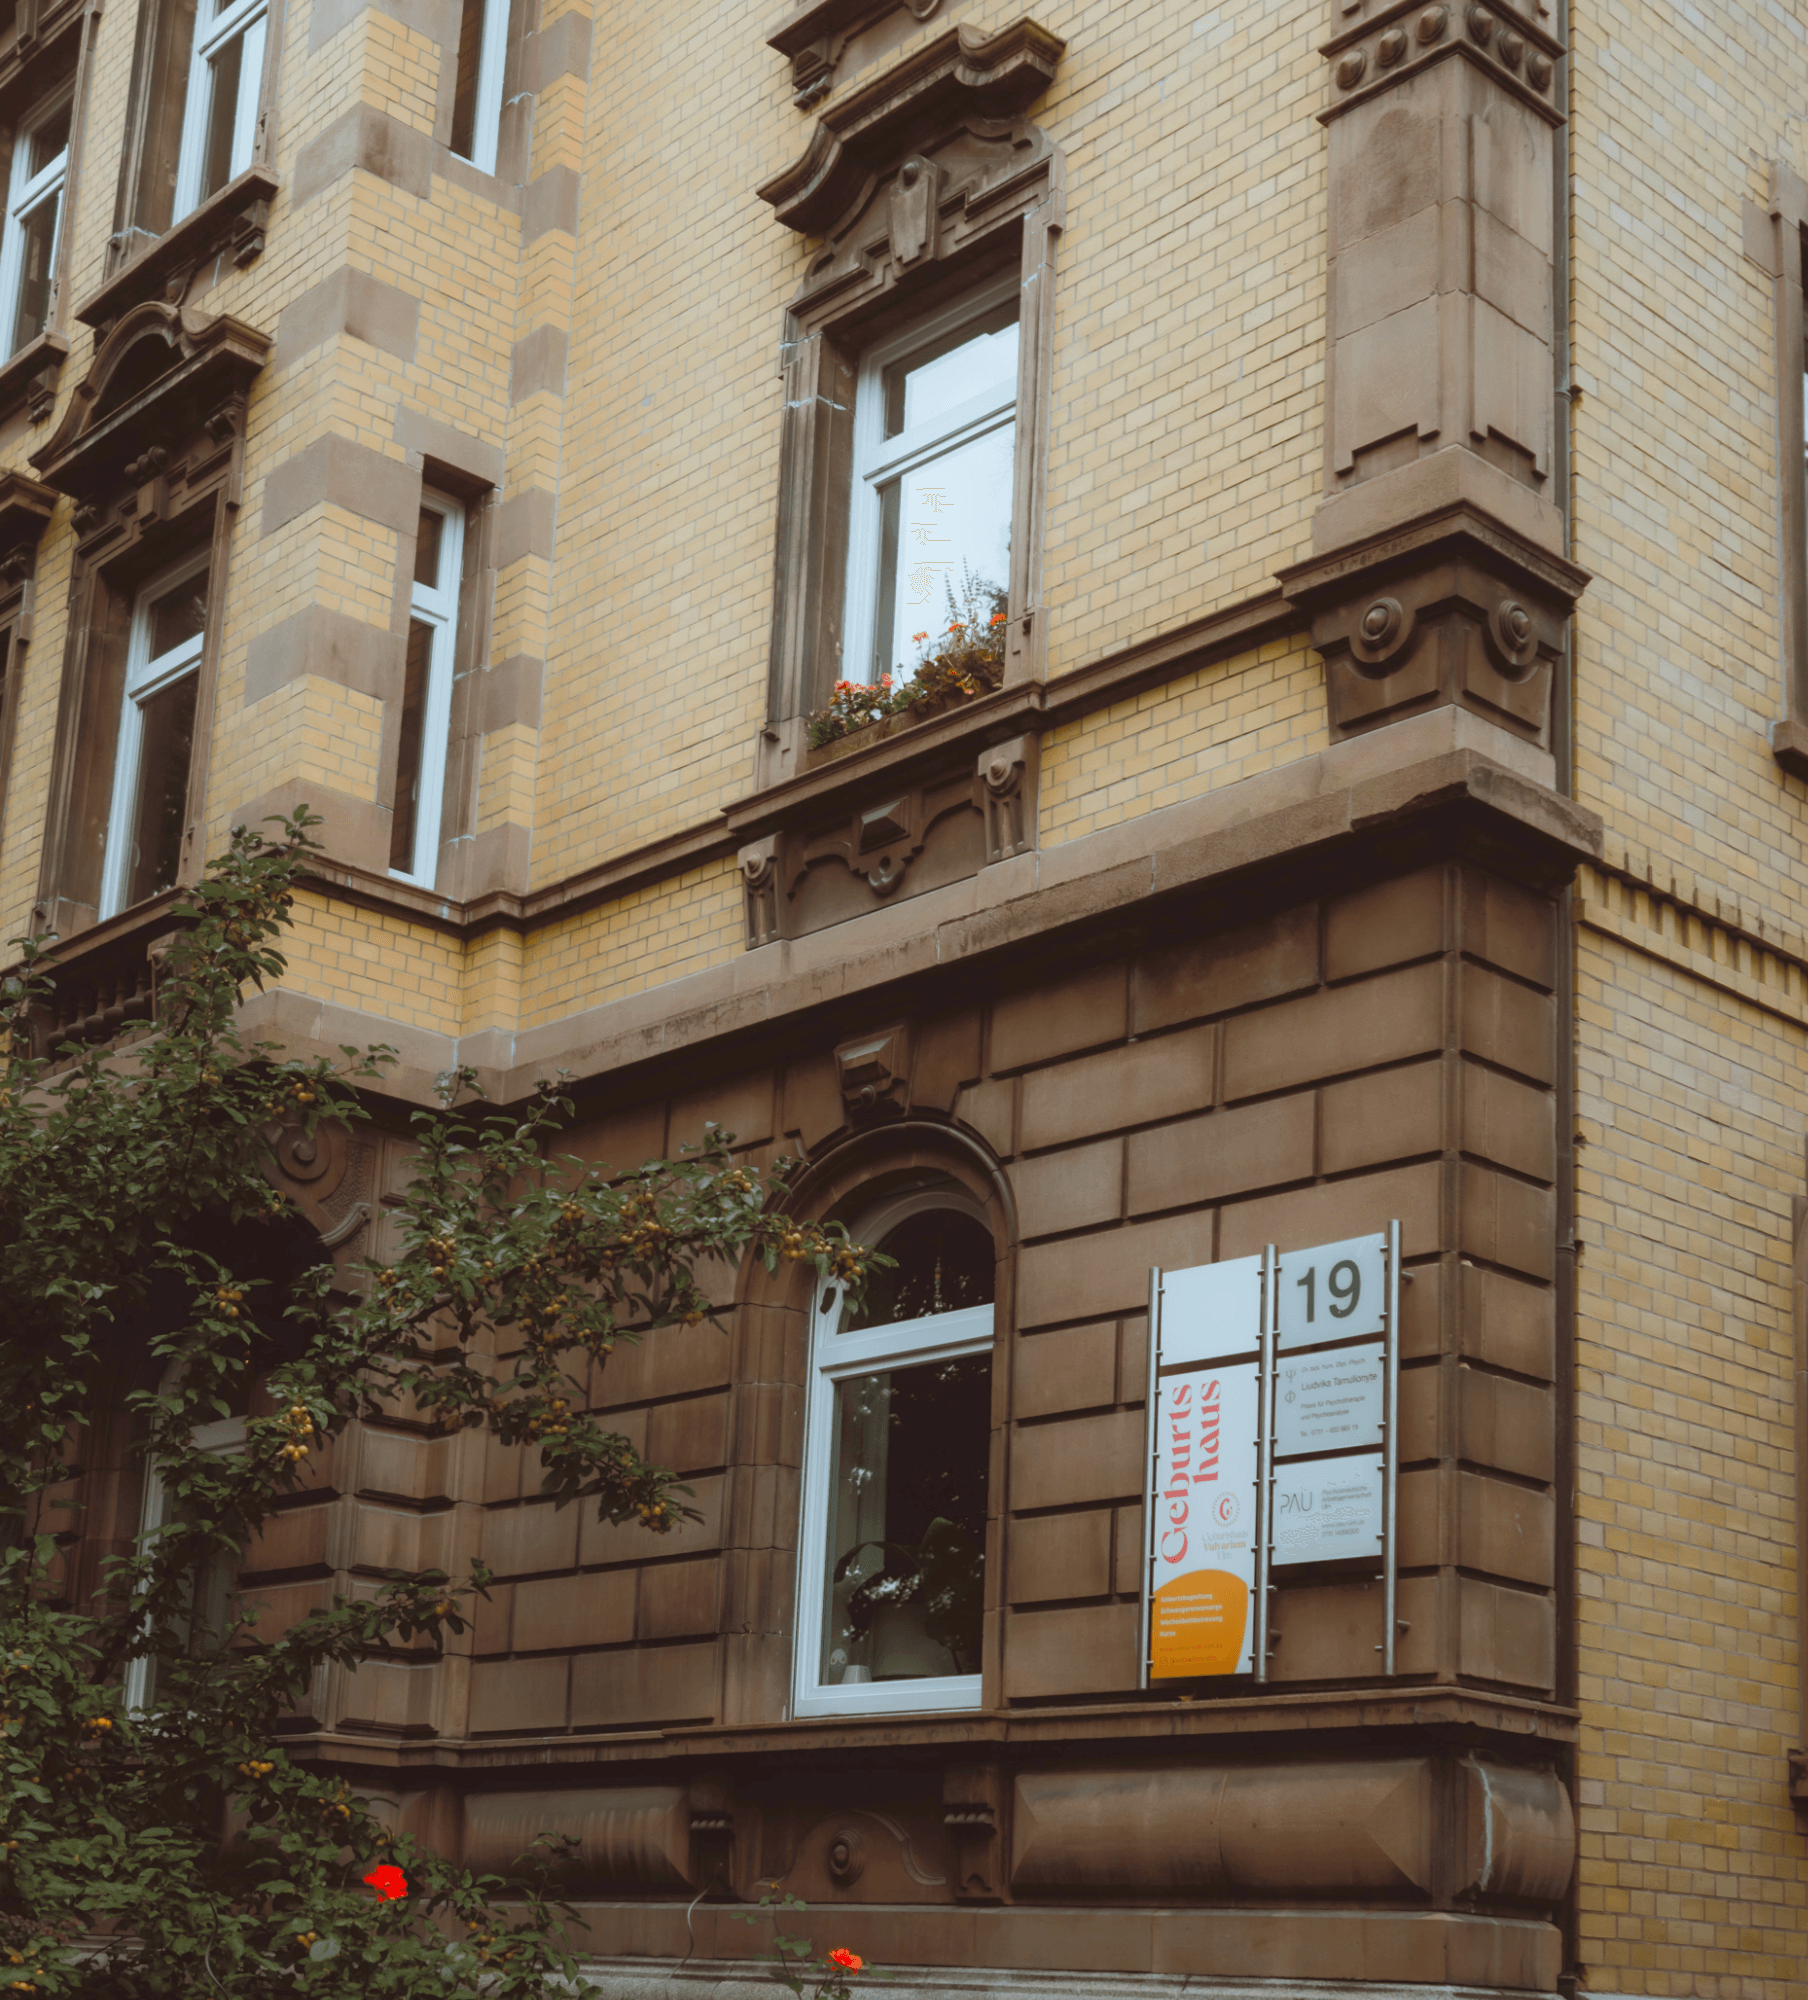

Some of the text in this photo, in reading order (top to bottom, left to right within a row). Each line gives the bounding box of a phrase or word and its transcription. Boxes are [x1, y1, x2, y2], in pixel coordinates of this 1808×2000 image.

[1297, 1260, 1361, 1323] 19
[1301, 1379, 1332, 1391] Liudvika
[1325, 1394, 1366, 1407] Psychotherapie
[1300, 1409, 1350, 1421] und Psychoanalyse
[1192, 1380, 1221, 1484] haus
[1161, 1384, 1193, 1564] Geburts
[1281, 1491, 1313, 1514] PAU
[1204, 1540, 1247, 1551] Vulvarium
